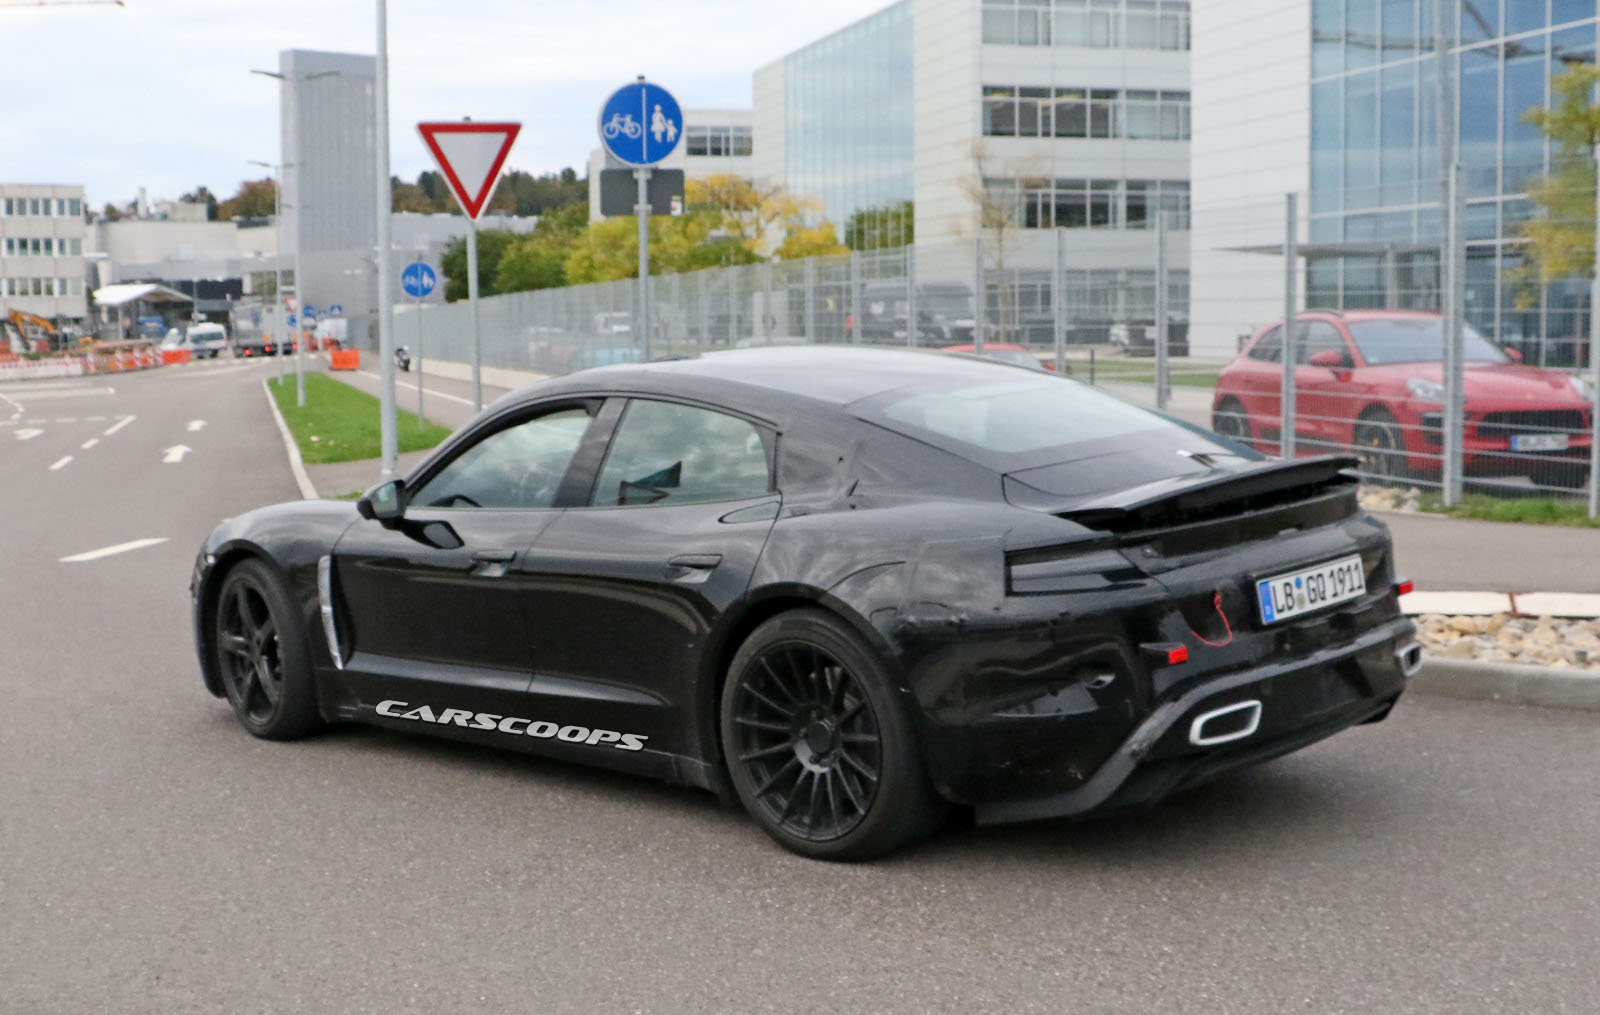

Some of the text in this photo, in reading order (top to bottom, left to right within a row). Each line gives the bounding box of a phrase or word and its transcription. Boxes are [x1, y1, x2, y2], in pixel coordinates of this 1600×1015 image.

[1272, 582, 1295, 613] LB
[1306, 573, 1327, 604] GQ
[1329, 562, 1363, 598] 1911
